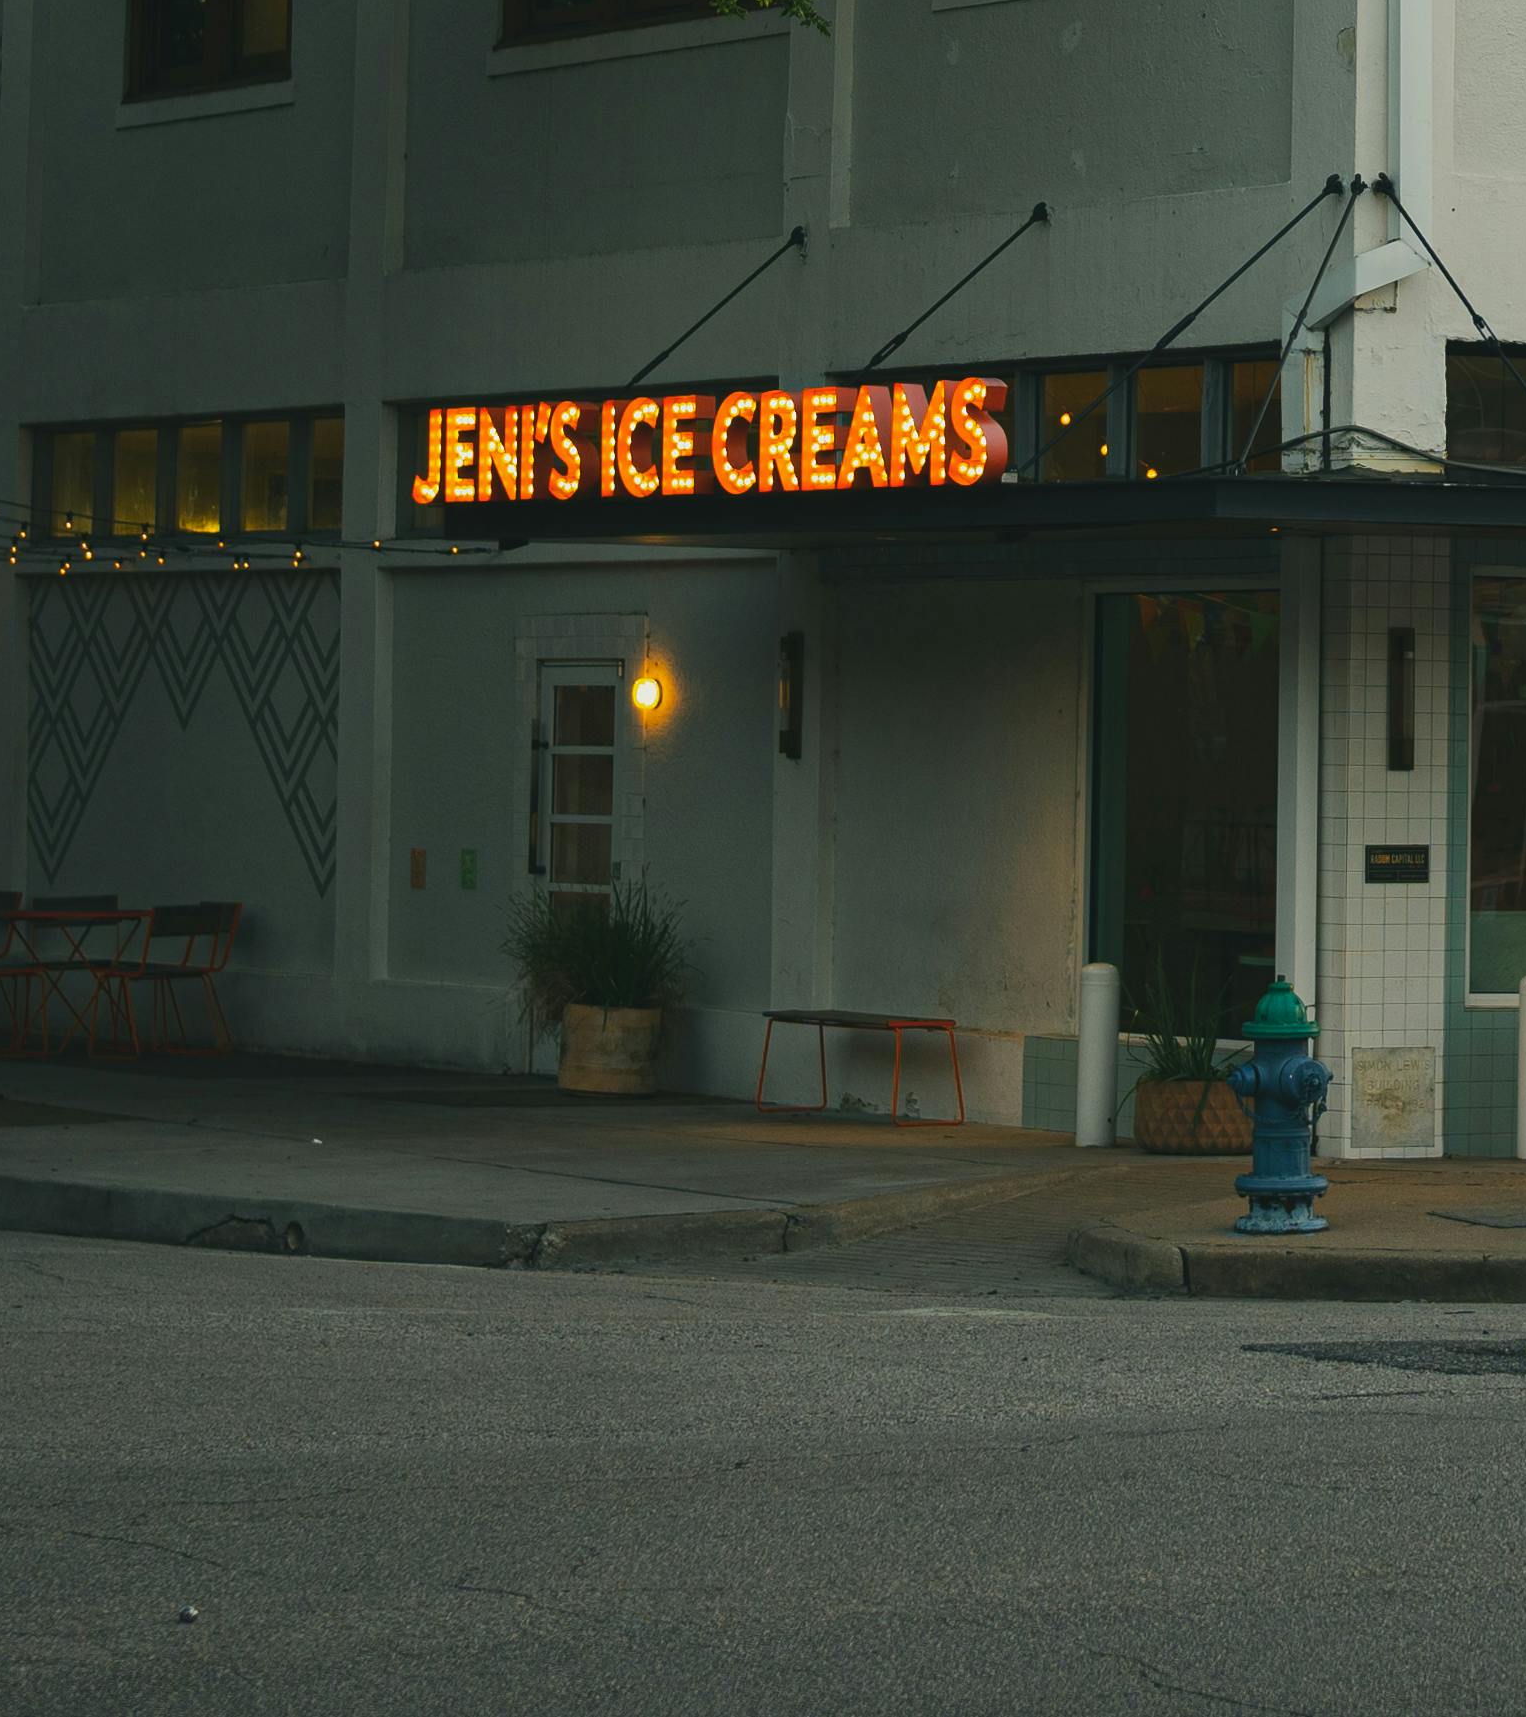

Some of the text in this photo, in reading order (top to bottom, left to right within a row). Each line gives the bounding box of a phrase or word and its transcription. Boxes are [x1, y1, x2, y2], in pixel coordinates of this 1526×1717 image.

[412, 377, 996, 504] JENI'S ICE CREAMS
